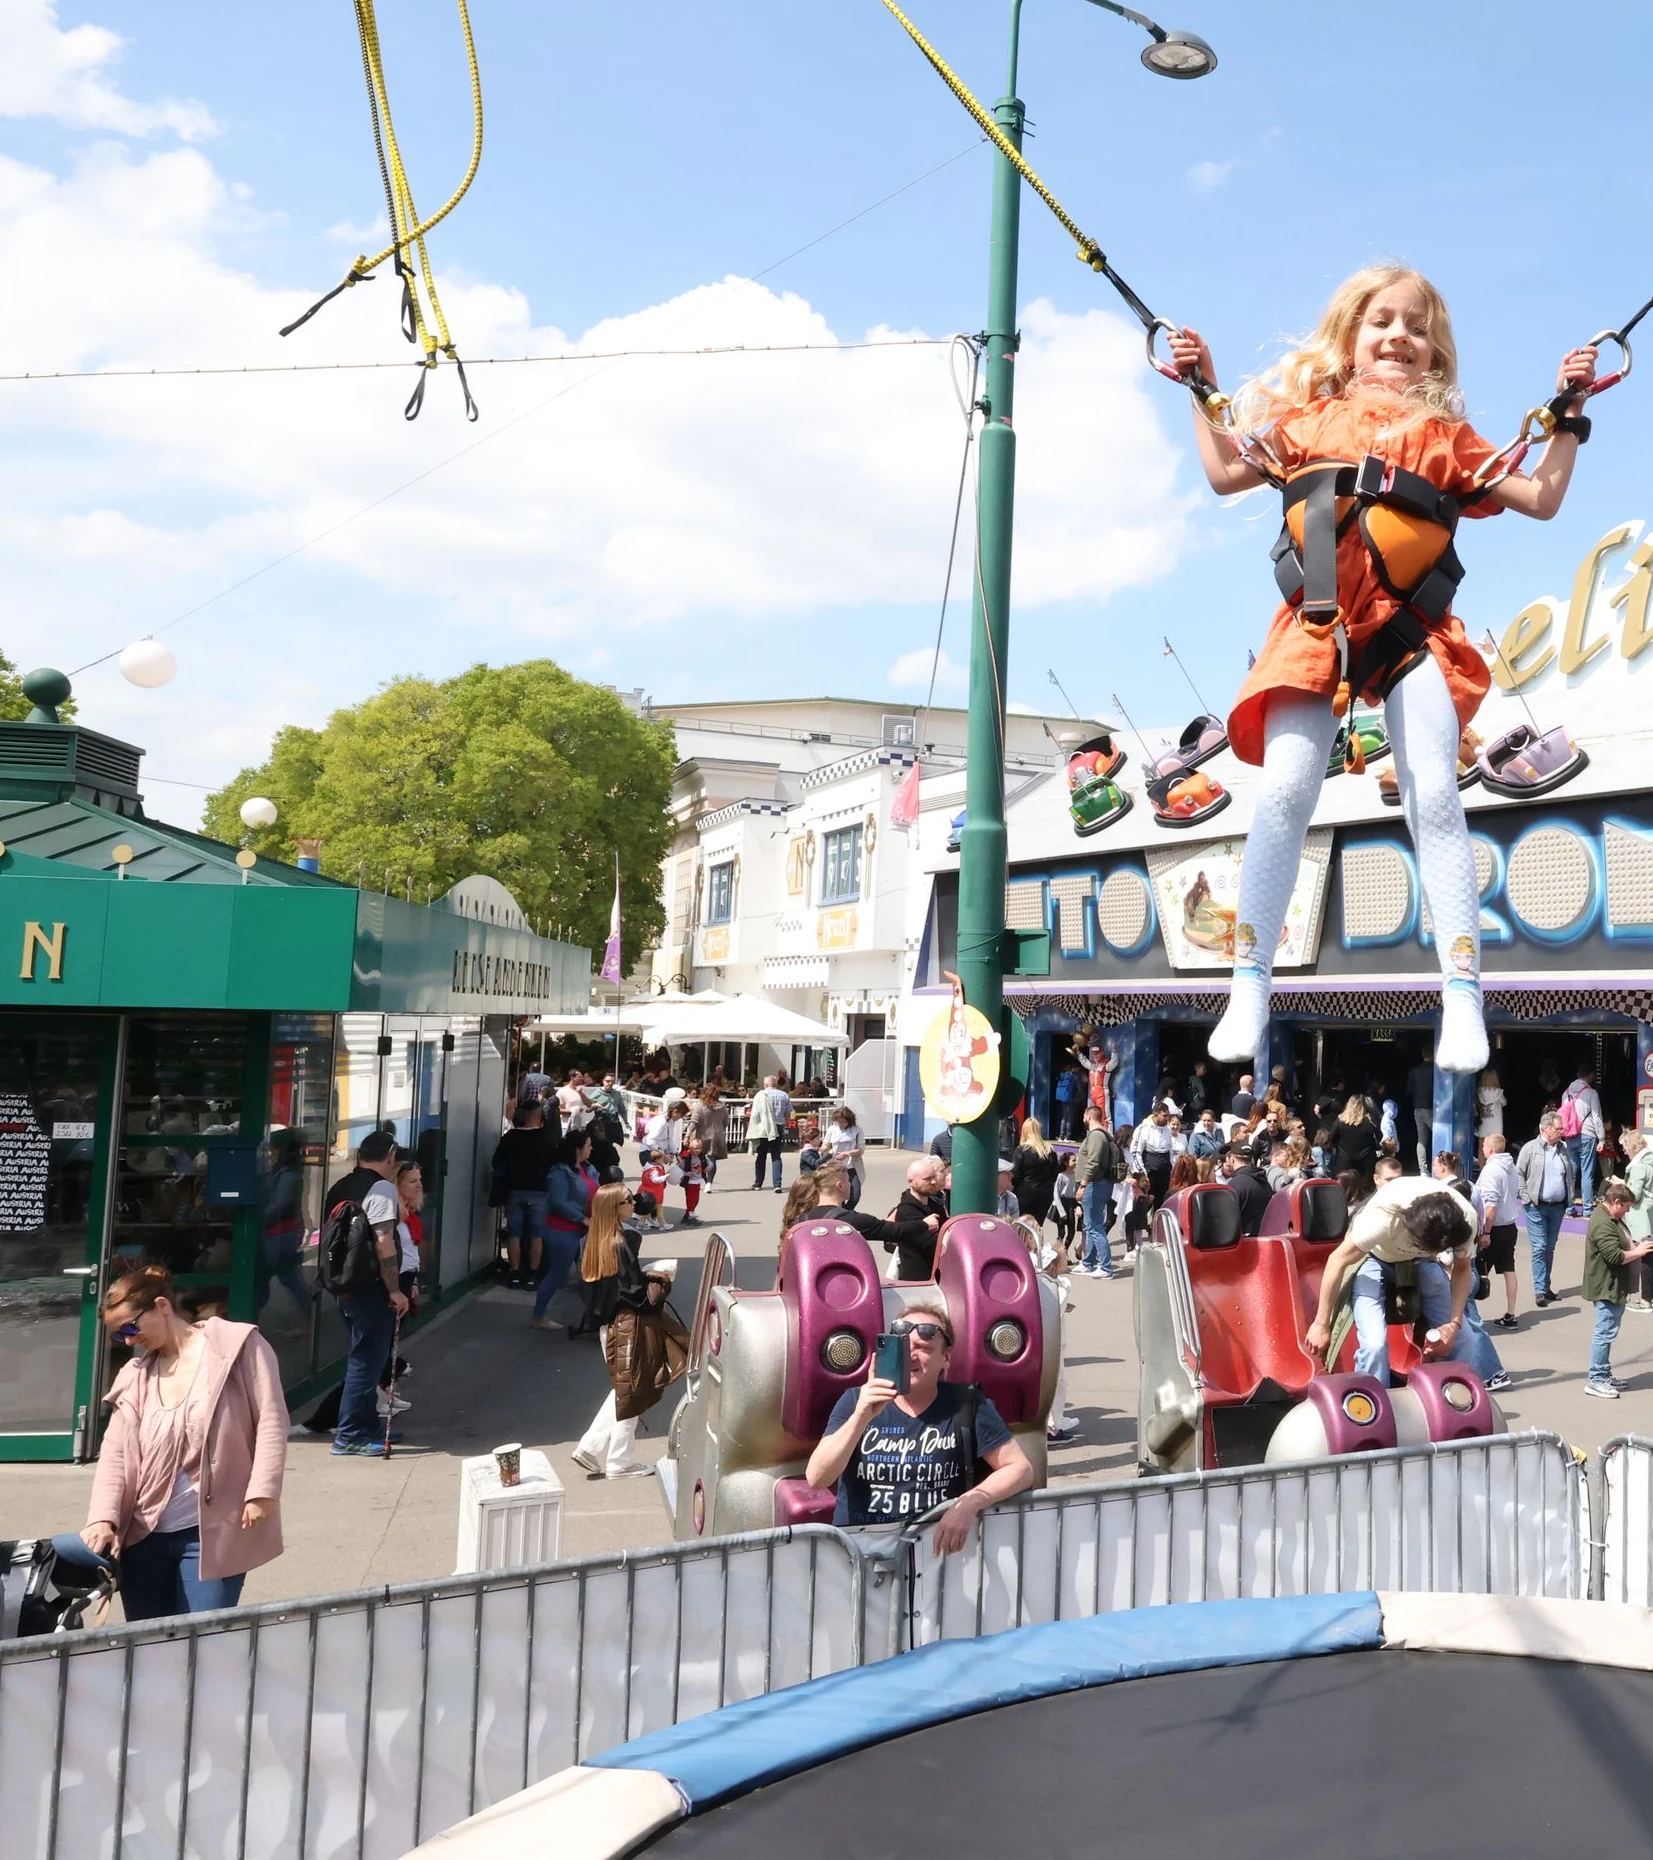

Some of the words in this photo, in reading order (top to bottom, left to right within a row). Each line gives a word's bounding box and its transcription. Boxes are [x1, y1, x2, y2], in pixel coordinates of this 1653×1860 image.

[1, 1132, 34, 1140] AUSTRIA
[0, 1141, 23, 1149] STRIA
[15, 1150, 49, 1158] AUSTRIA
[4, 1158, 38, 1166] AUSTRIA
[10, 1192, 43, 1200] AUSTRIA
[0, 1200, 32, 1208] AUSTRIA
[881, 1426, 905, 1434] SHORES
[861, 1428, 916, 1465] Camp
[866, 1455, 900, 1463] NORTHERN
[857, 1462, 912, 1482] ARCTIC
[916, 1461, 960, 1481] CIRCLE
[867, 1490, 894, 1514] 25
